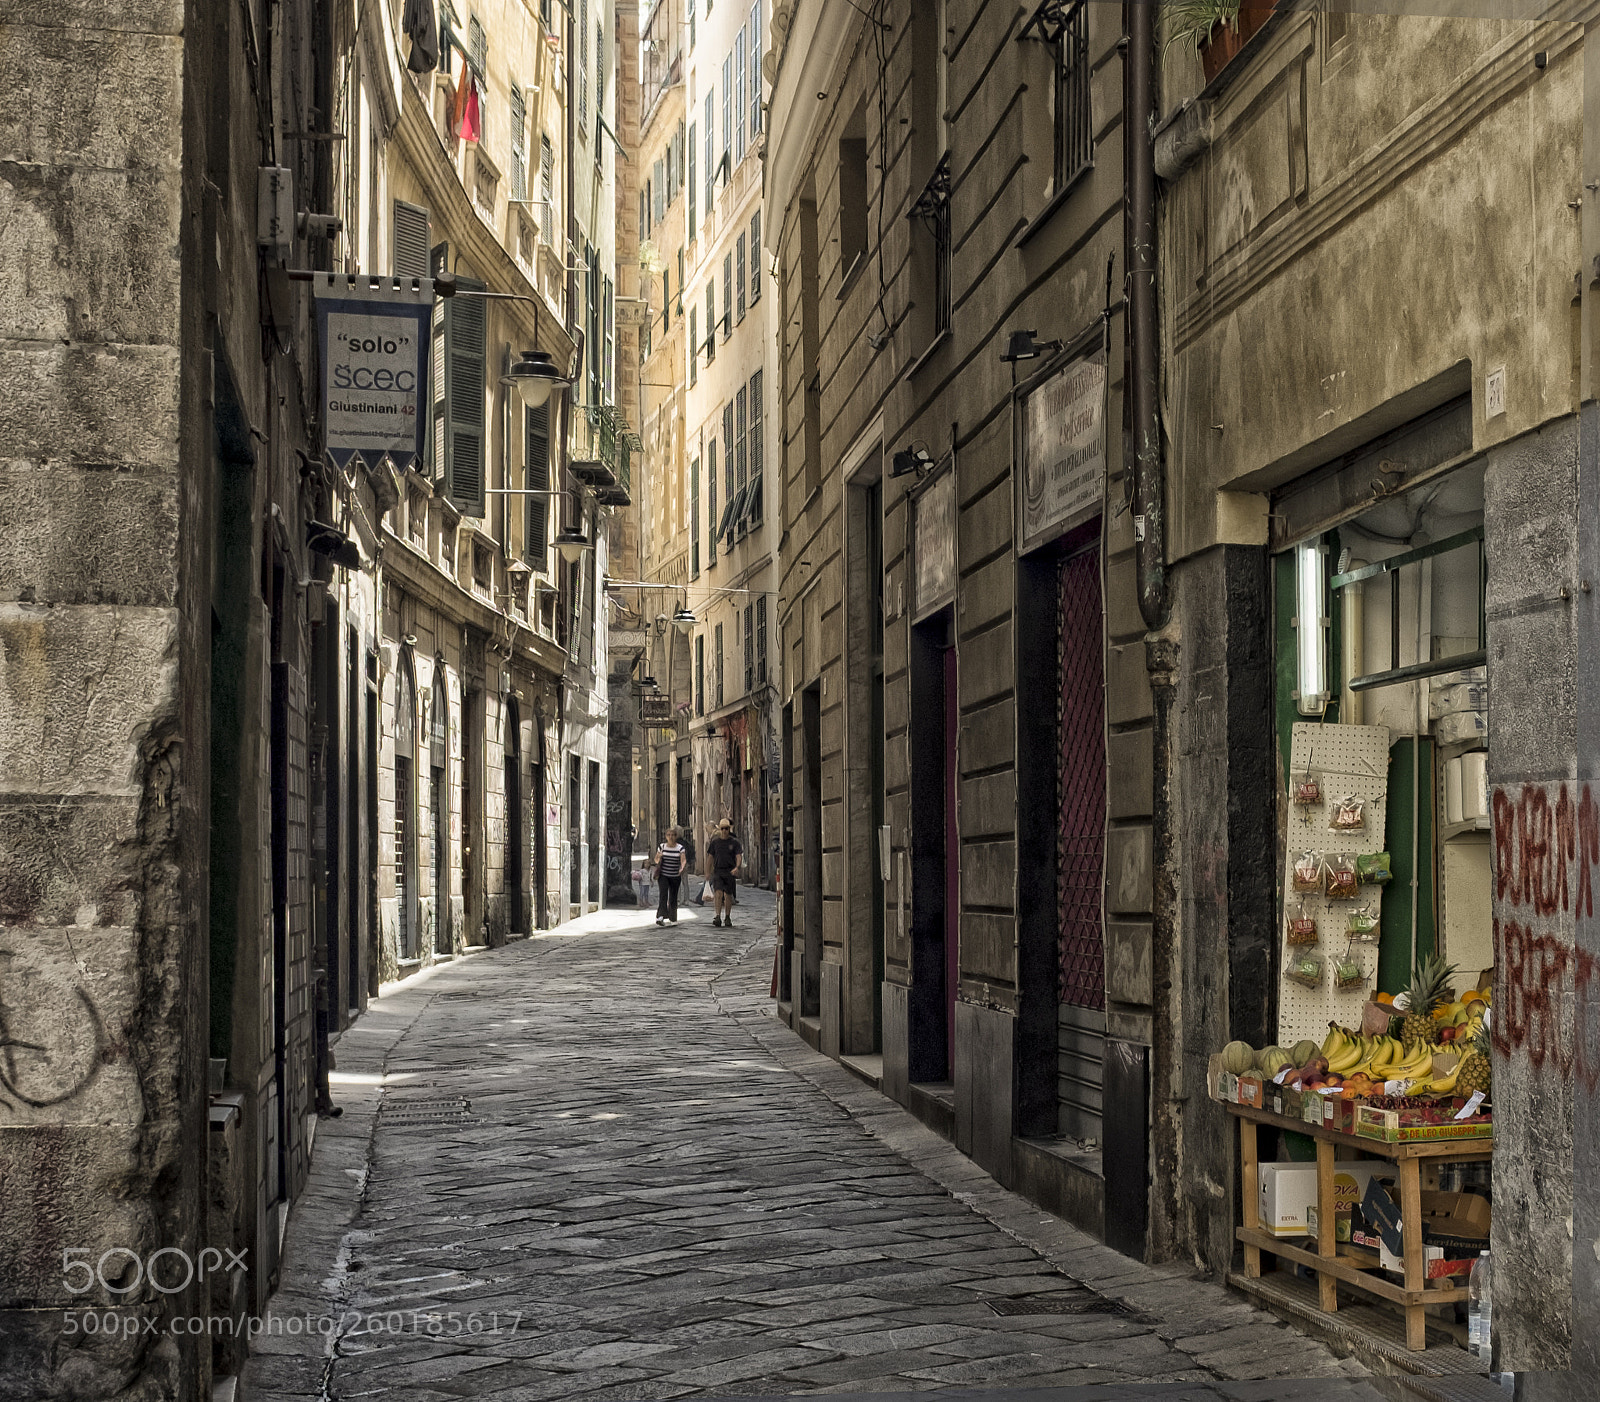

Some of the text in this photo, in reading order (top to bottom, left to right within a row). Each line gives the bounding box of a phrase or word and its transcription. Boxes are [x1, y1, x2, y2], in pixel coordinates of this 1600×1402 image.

[329, 401, 415, 416] Giustiniani 42
[1409, 1129, 1419, 1138] DE
[1422, 1128, 1437, 1138] LEO
[1439, 1126, 1477, 1137] GIUSEPPE
